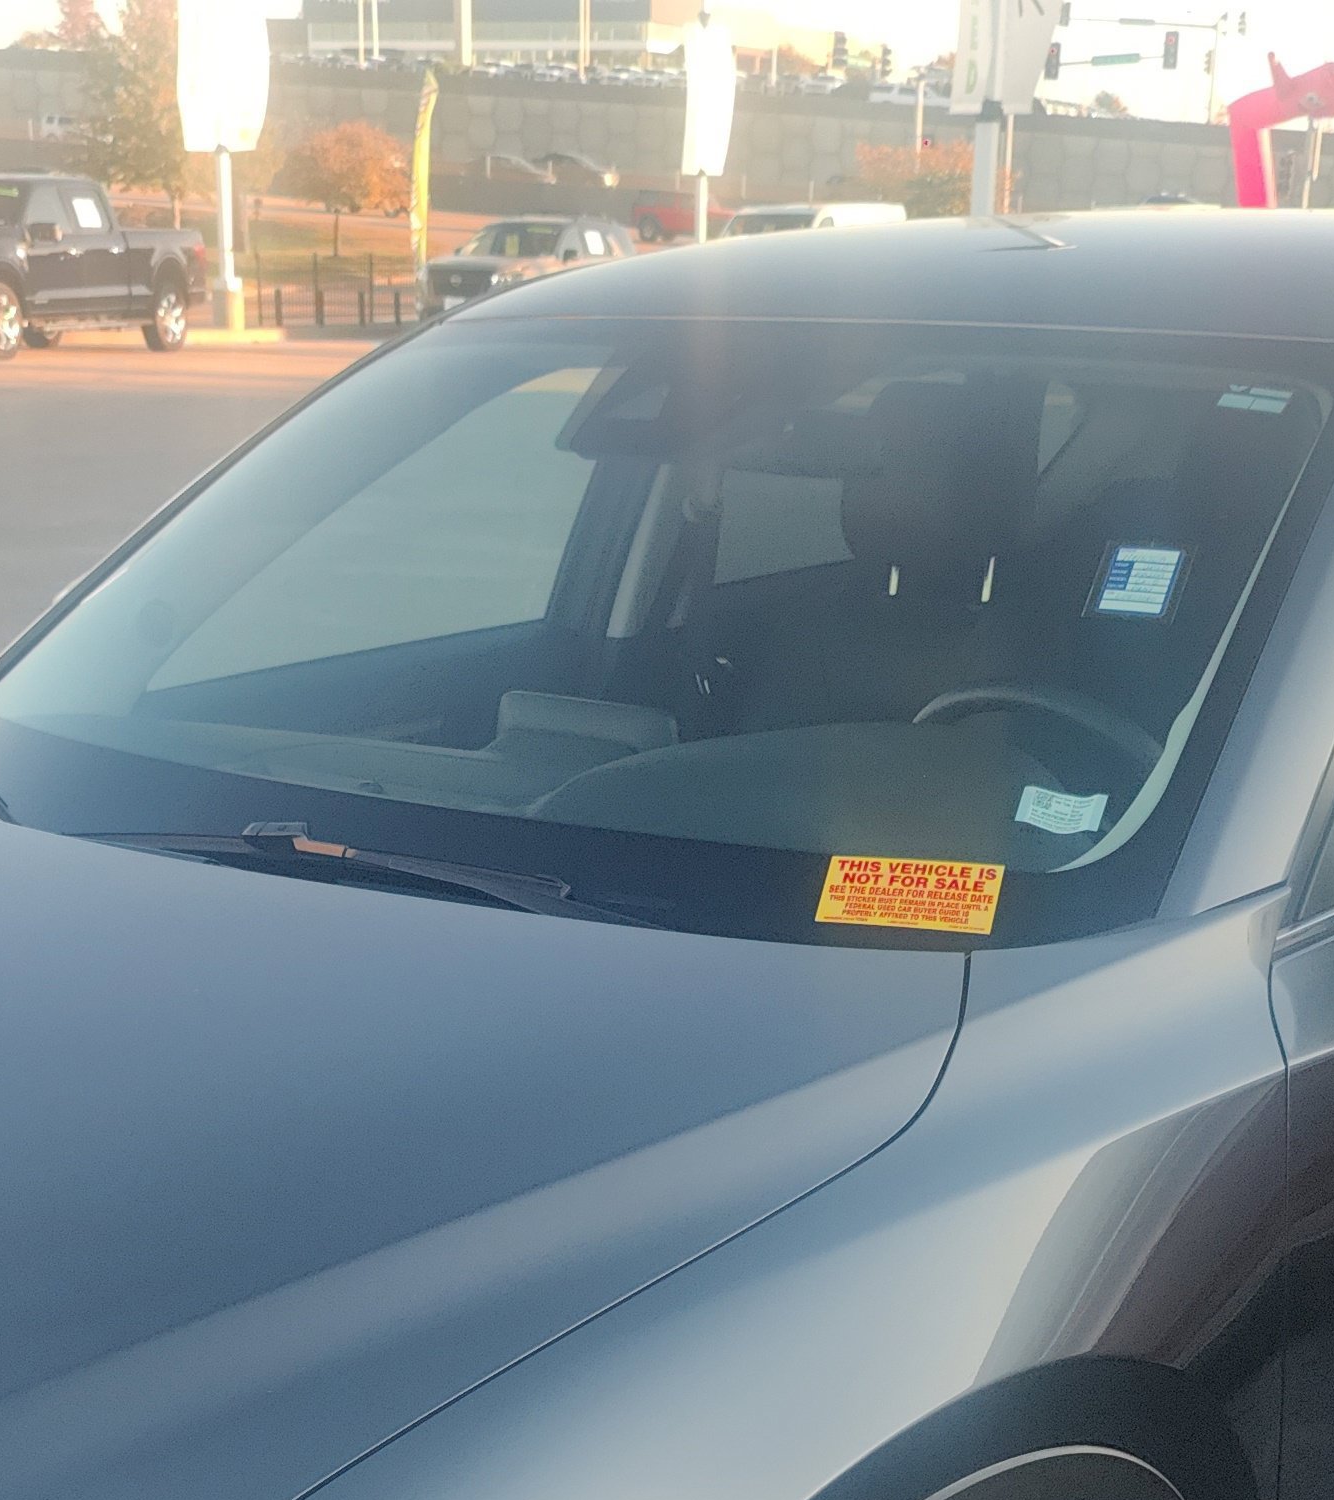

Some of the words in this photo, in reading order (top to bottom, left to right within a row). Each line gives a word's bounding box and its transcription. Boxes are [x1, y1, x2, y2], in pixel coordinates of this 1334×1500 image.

[838, 860, 881, 872] THIS
[888, 862, 972, 879] VEHICLE
[978, 868, 997, 880] IS
[842, 873, 883, 885] NOT
[888, 874, 928, 888] FOR
[934, 878, 985, 892] SALE
[829, 885, 846, 893] SEE
[849, 886, 867, 895] THE
[869, 886, 903, 896] DEALER
[906, 889, 924, 898] FOR
[927, 890, 968, 901] RELEASE
[971, 894, 993, 904] DATE
[842, 909, 877, 917] PROPERLY
[939, 916, 969, 924] VEHICLE
